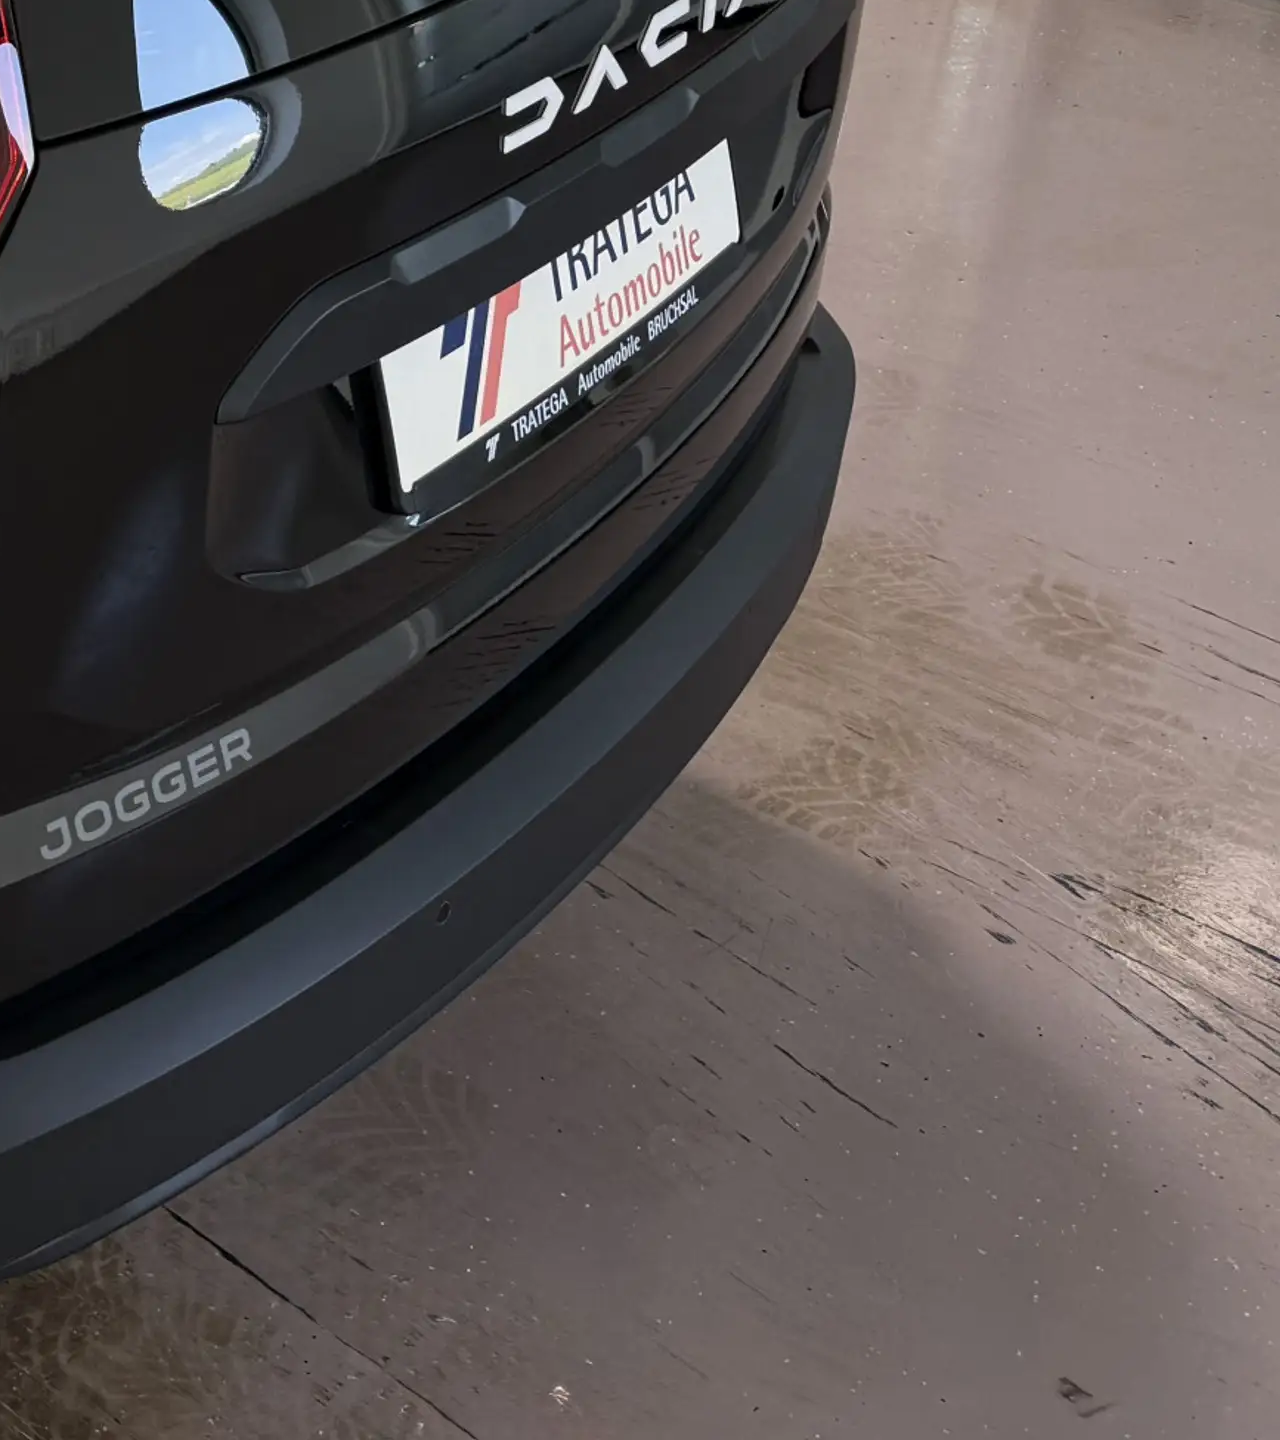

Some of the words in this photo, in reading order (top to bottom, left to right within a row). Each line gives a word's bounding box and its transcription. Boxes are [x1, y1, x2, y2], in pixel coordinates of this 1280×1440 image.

[511, 387, 569, 442] TRATEGA
[577, 333, 642, 396] Automobile
[647, 285, 700, 341] BRUCHSAL
[559, 224, 703, 369] Automobile
[40, 727, 253, 860] JOGGER
